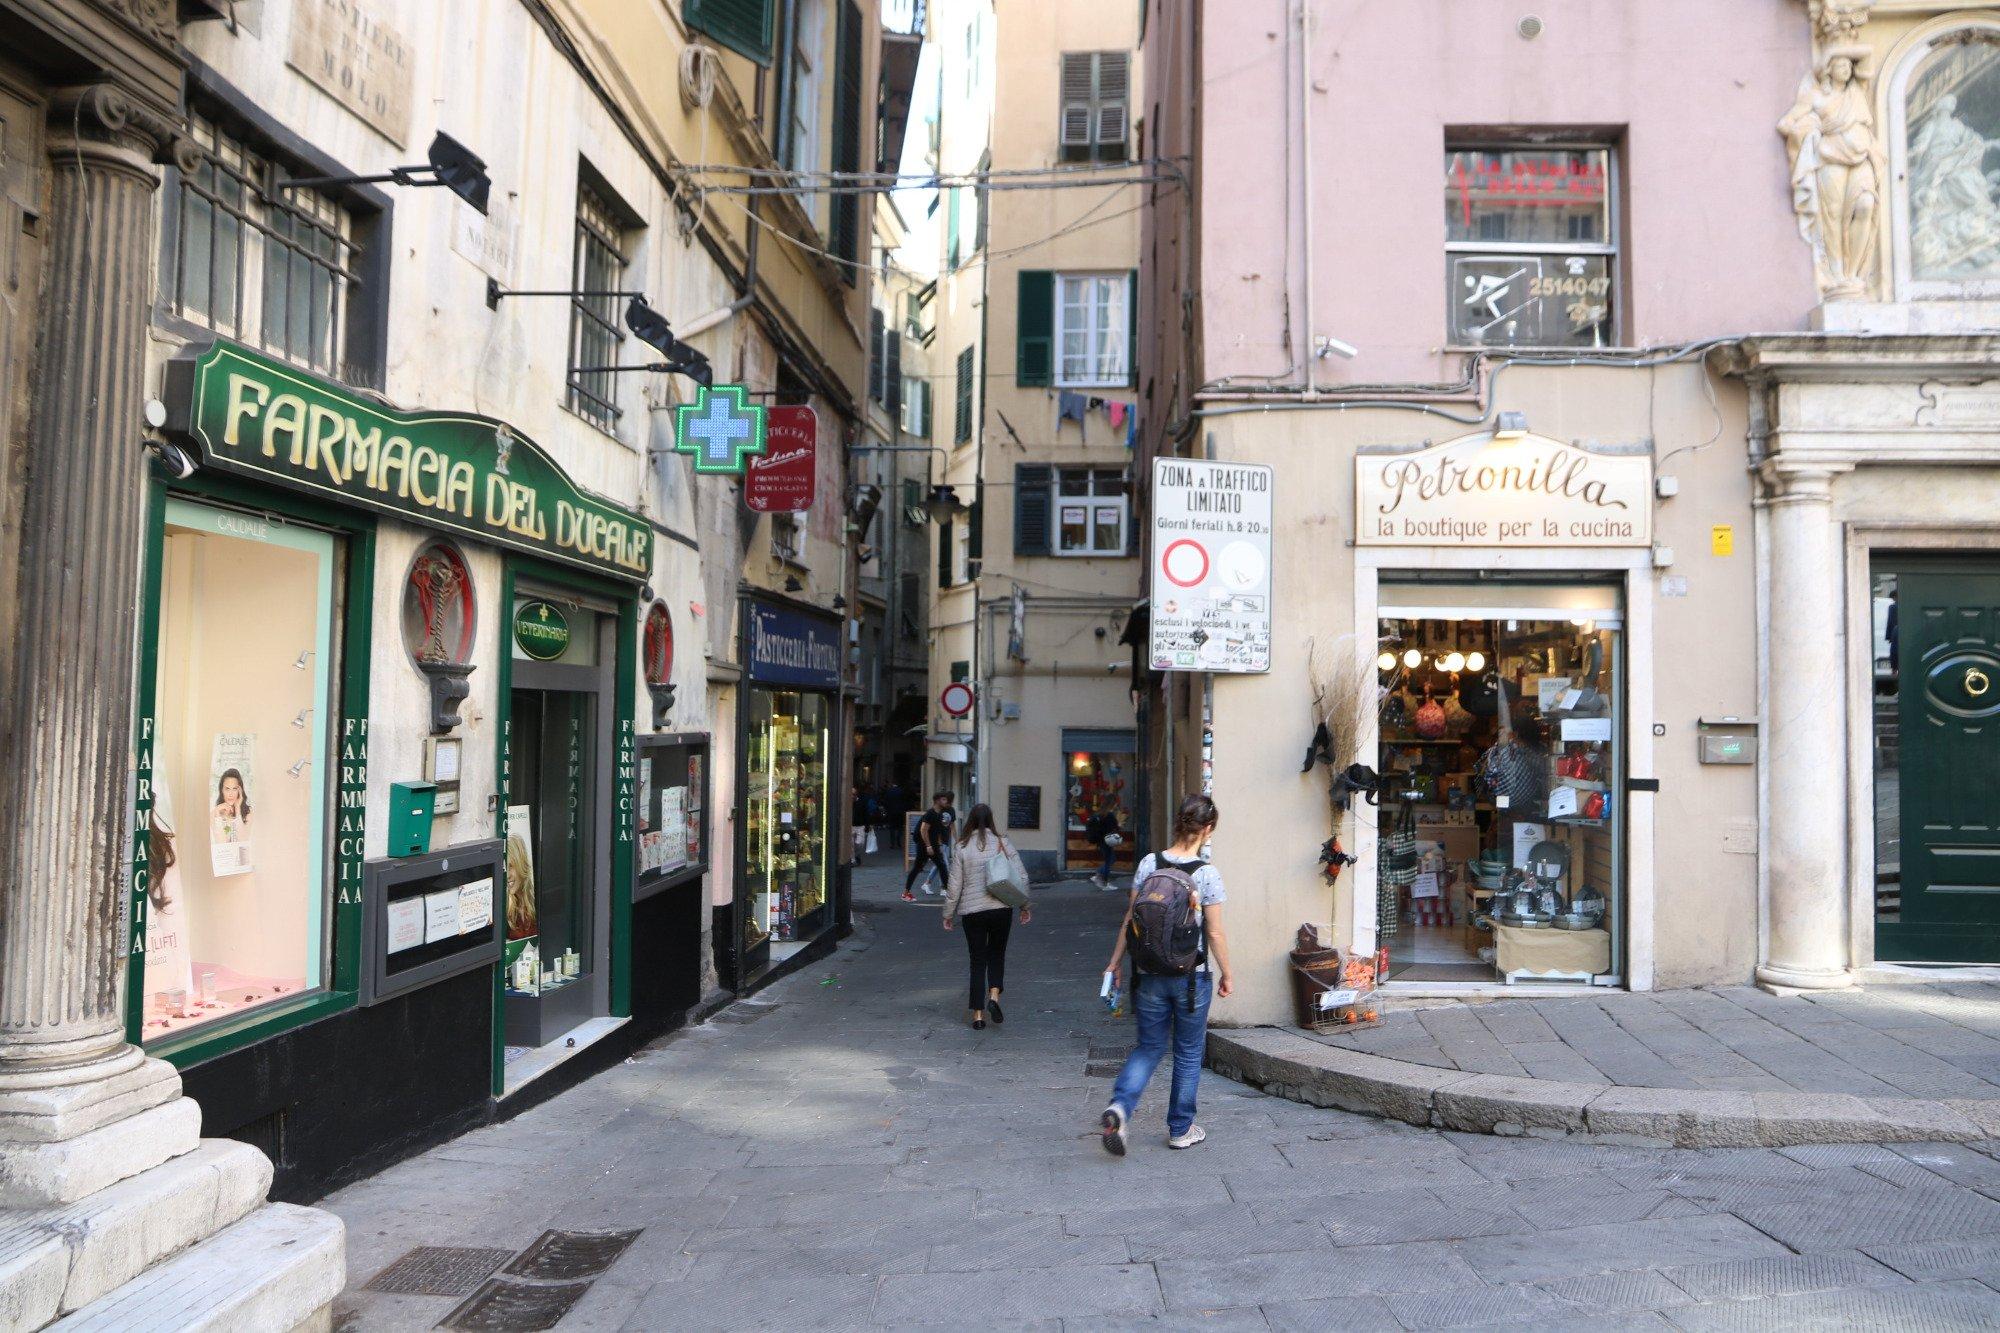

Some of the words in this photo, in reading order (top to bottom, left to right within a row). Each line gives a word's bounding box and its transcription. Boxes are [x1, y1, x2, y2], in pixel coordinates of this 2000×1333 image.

[321, 47, 386, 117] MOLO
[1529, 277, 1610, 297] 2514047
[223, 372, 475, 518] FARMACIA
[485, 473, 546, 541] DEL
[556, 500, 647, 573] DUCALE
[1160, 465, 1194, 488] ZONA
[1209, 467, 1268, 492] TRAFFICO
[1378, 450, 1628, 514] Petronilla
[1157, 516, 1189, 530] Giorni
[1191, 518, 1224, 532] feriali
[1186, 491, 1243, 514] LIMITATO
[217, 514, 268, 539] CAUDALIE
[1378, 517, 1394, 537] la
[1403, 517, 1488, 542] boutique
[1499, 521, 1532, 542] per
[1542, 517, 1559, 537] la
[1569, 518, 1633, 538] cucina
[1154, 618, 1183, 627] esclusi
[502, 720, 511, 873] FARMACIA
[619, 720, 630, 841] FARMACIA
[338, 718, 356, 904] FARMACIA
[131, 717, 153, 955] FARMACIA
